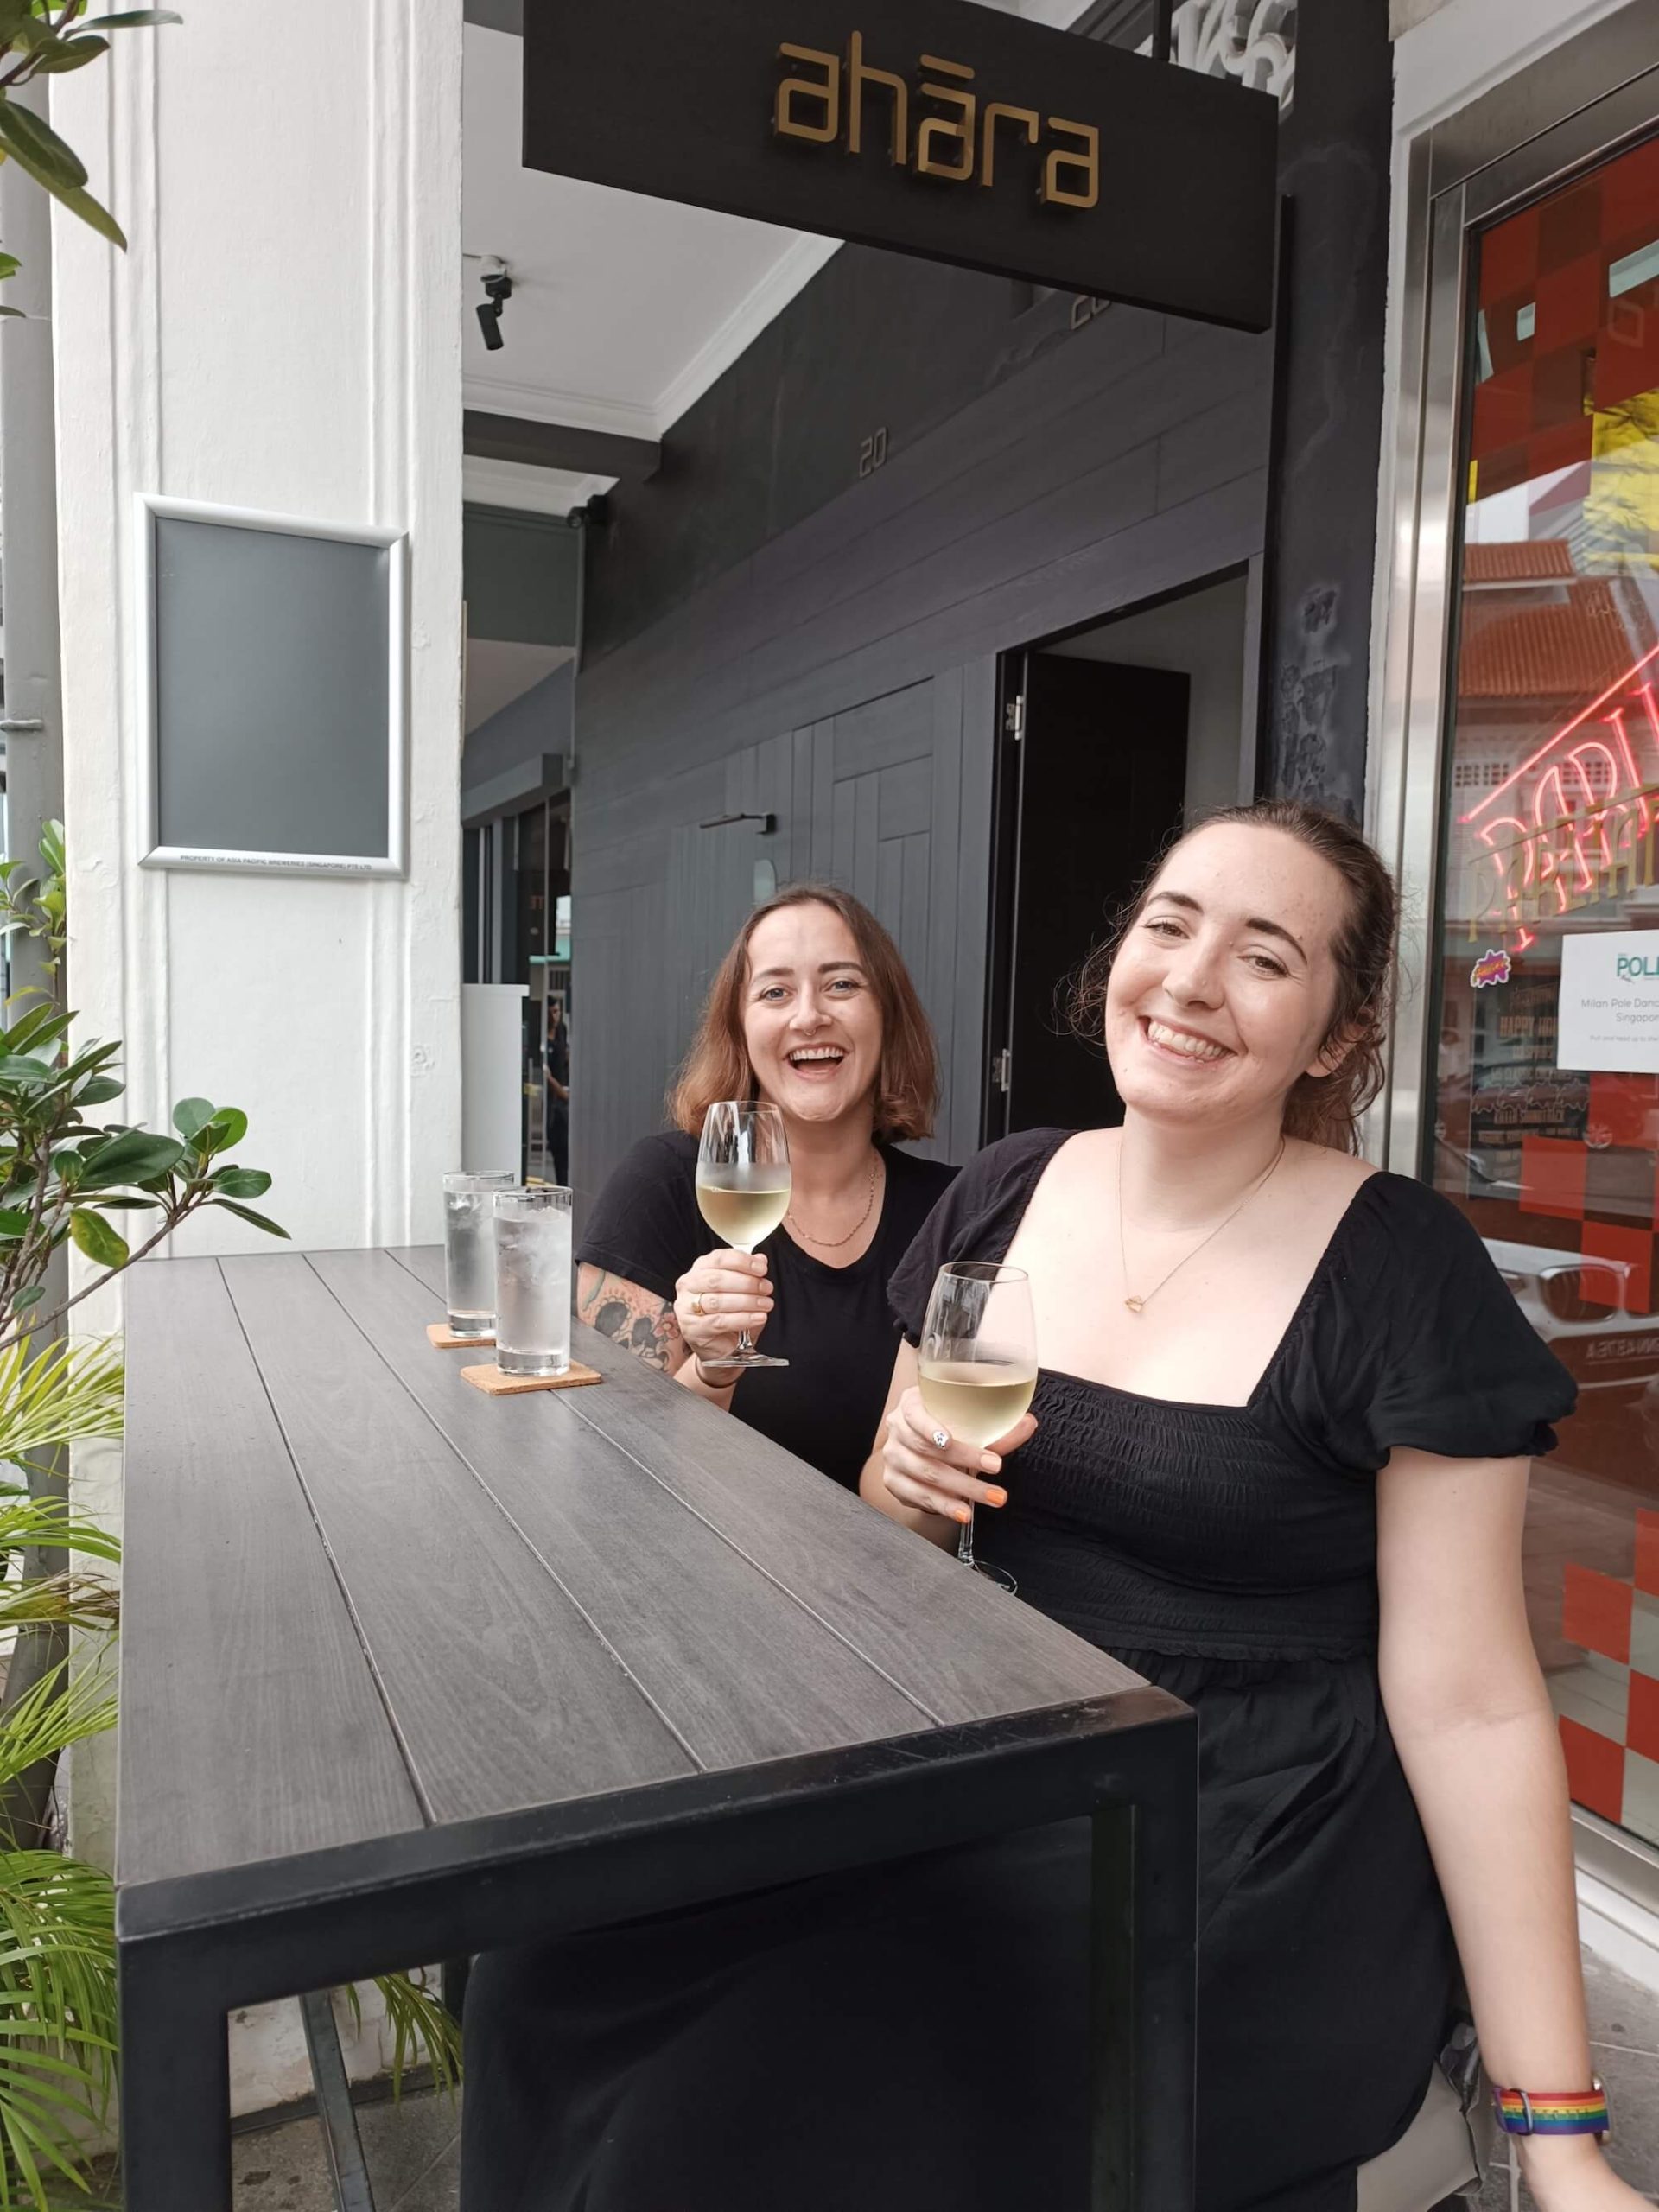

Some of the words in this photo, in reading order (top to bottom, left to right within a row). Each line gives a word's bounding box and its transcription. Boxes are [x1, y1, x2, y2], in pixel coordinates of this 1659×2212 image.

[772, 29, 1100, 210] ahāra
[859, 426, 887, 478] 20
[1616, 956, 1659, 977] POL
[1581, 998, 1608, 1008] Milan
[1611, 997, 1632, 1008] Pole
